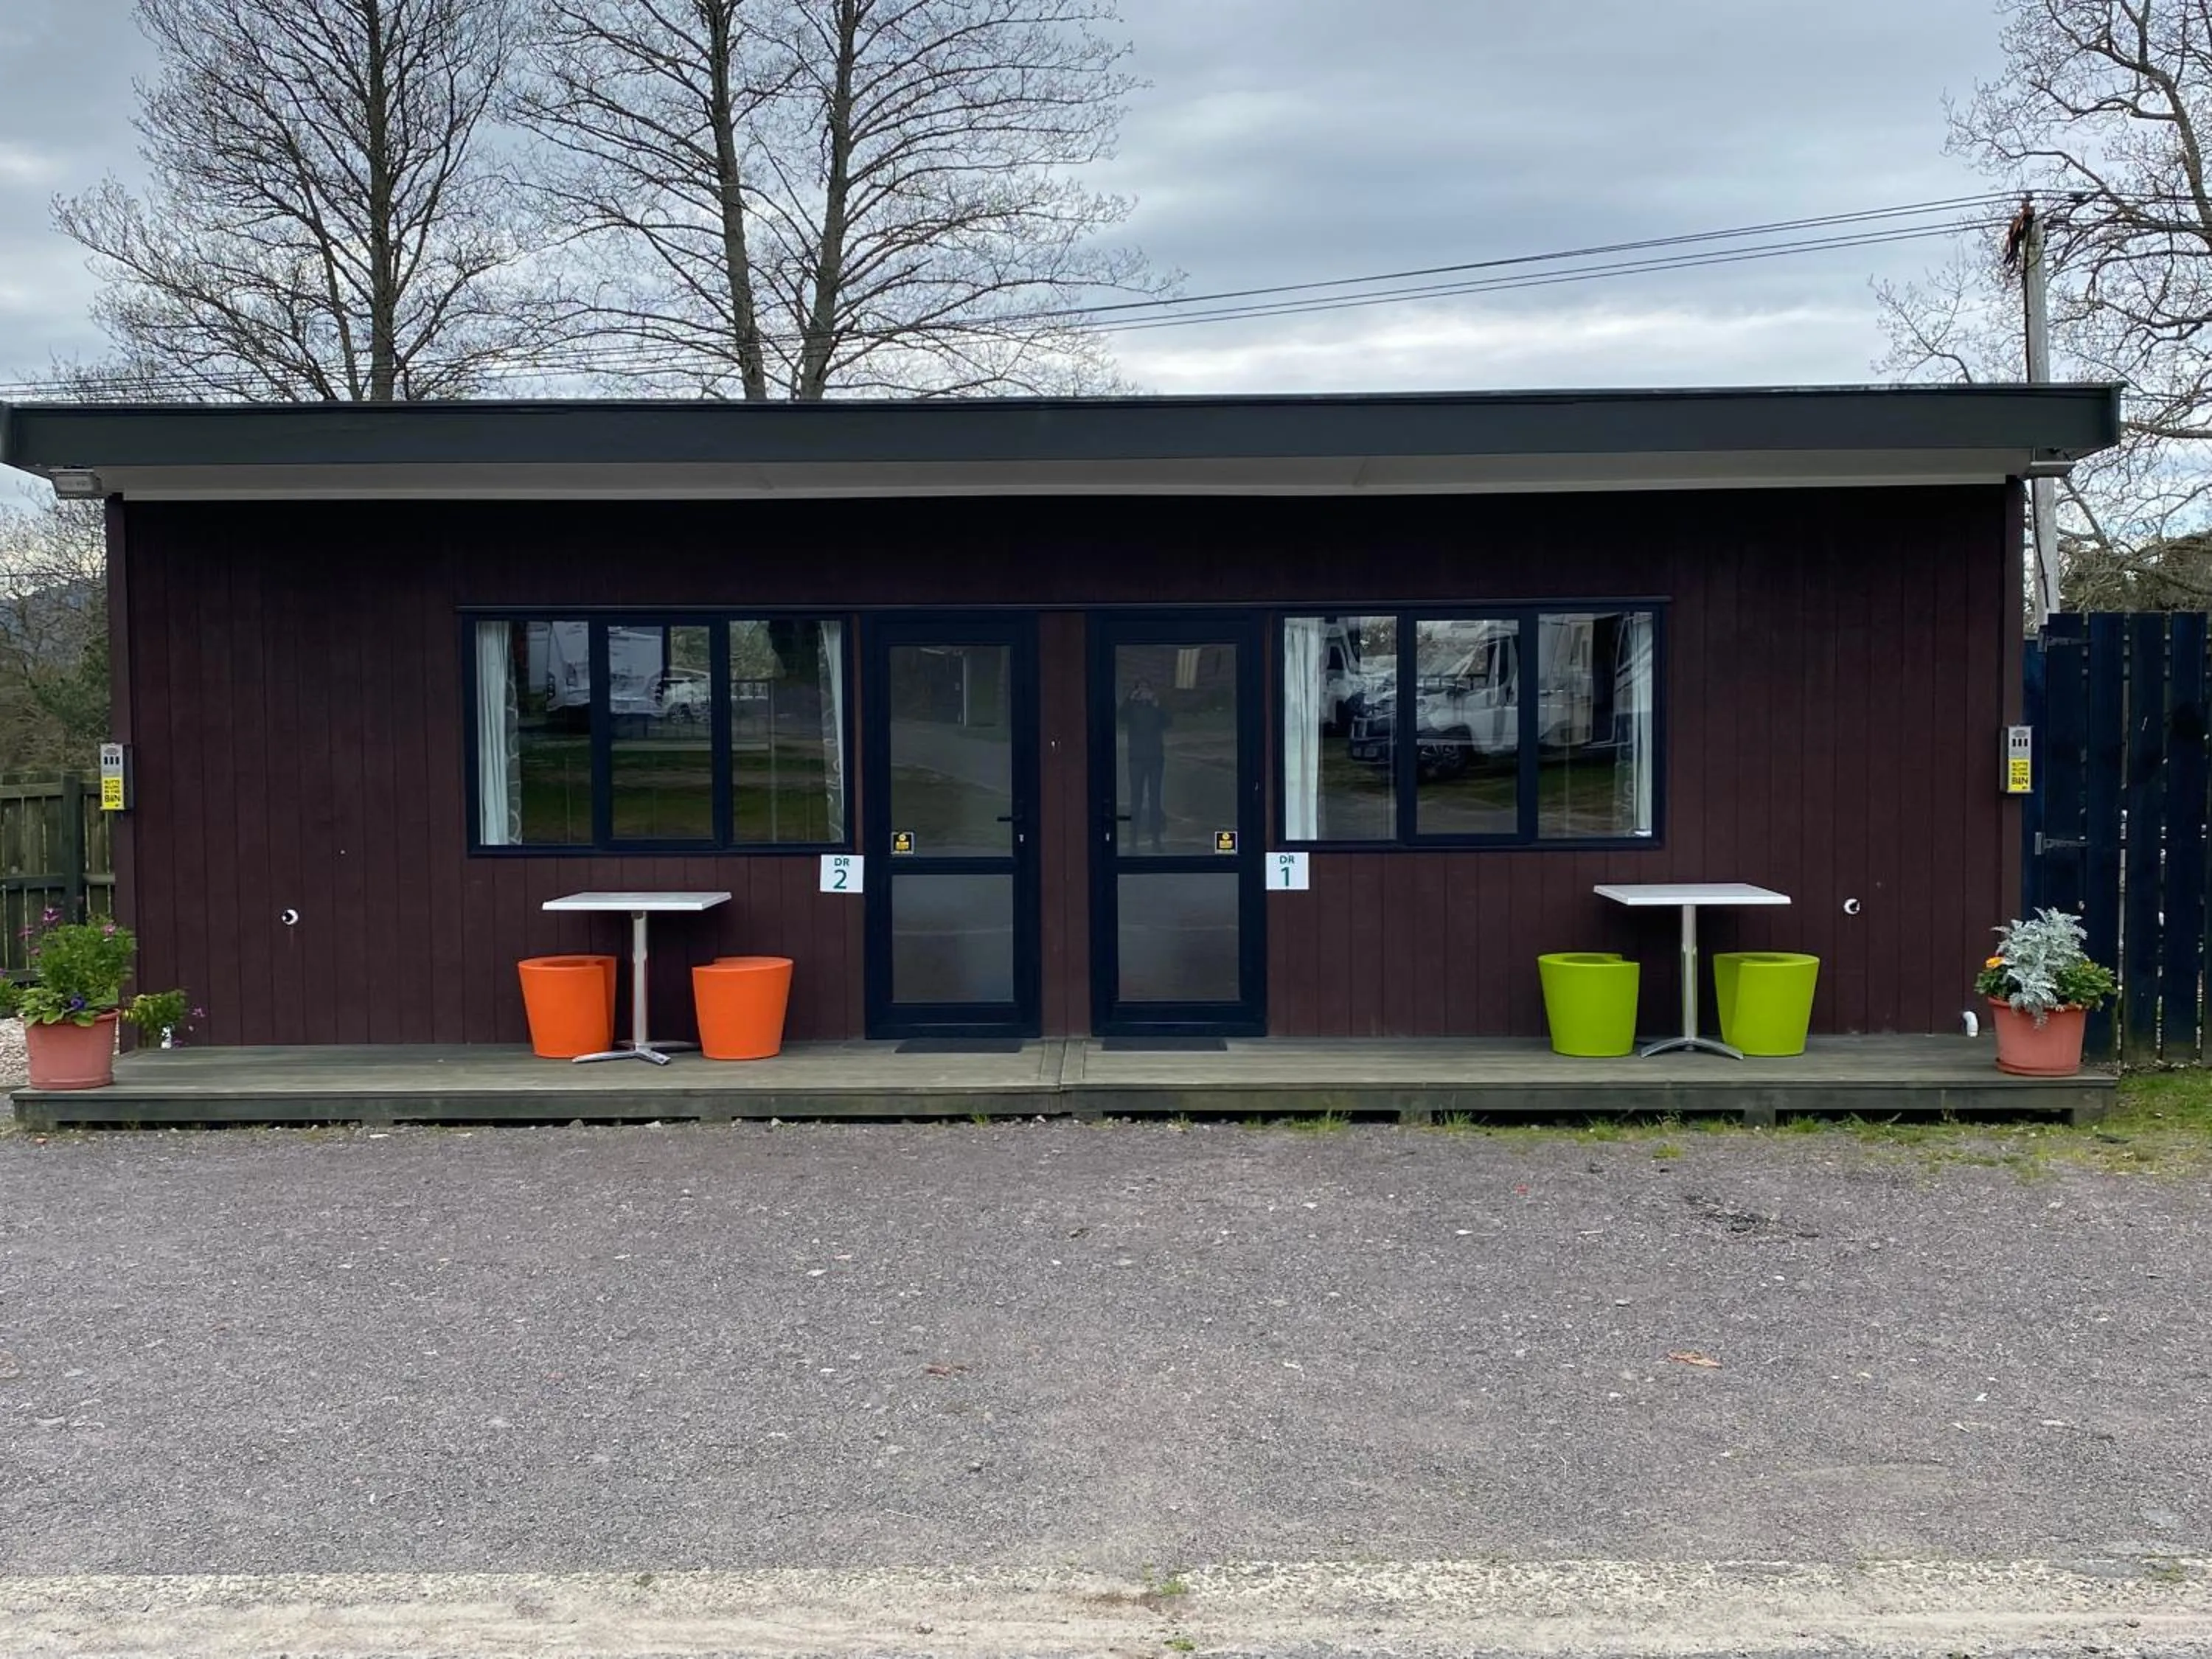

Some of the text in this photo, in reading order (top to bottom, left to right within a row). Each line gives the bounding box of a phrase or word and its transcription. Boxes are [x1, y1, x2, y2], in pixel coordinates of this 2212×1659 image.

[834, 858, 850, 866] DR
[1279, 855, 1295, 864] DR
[833, 869, 847, 890] 2
[1281, 867, 1290, 887] 1
